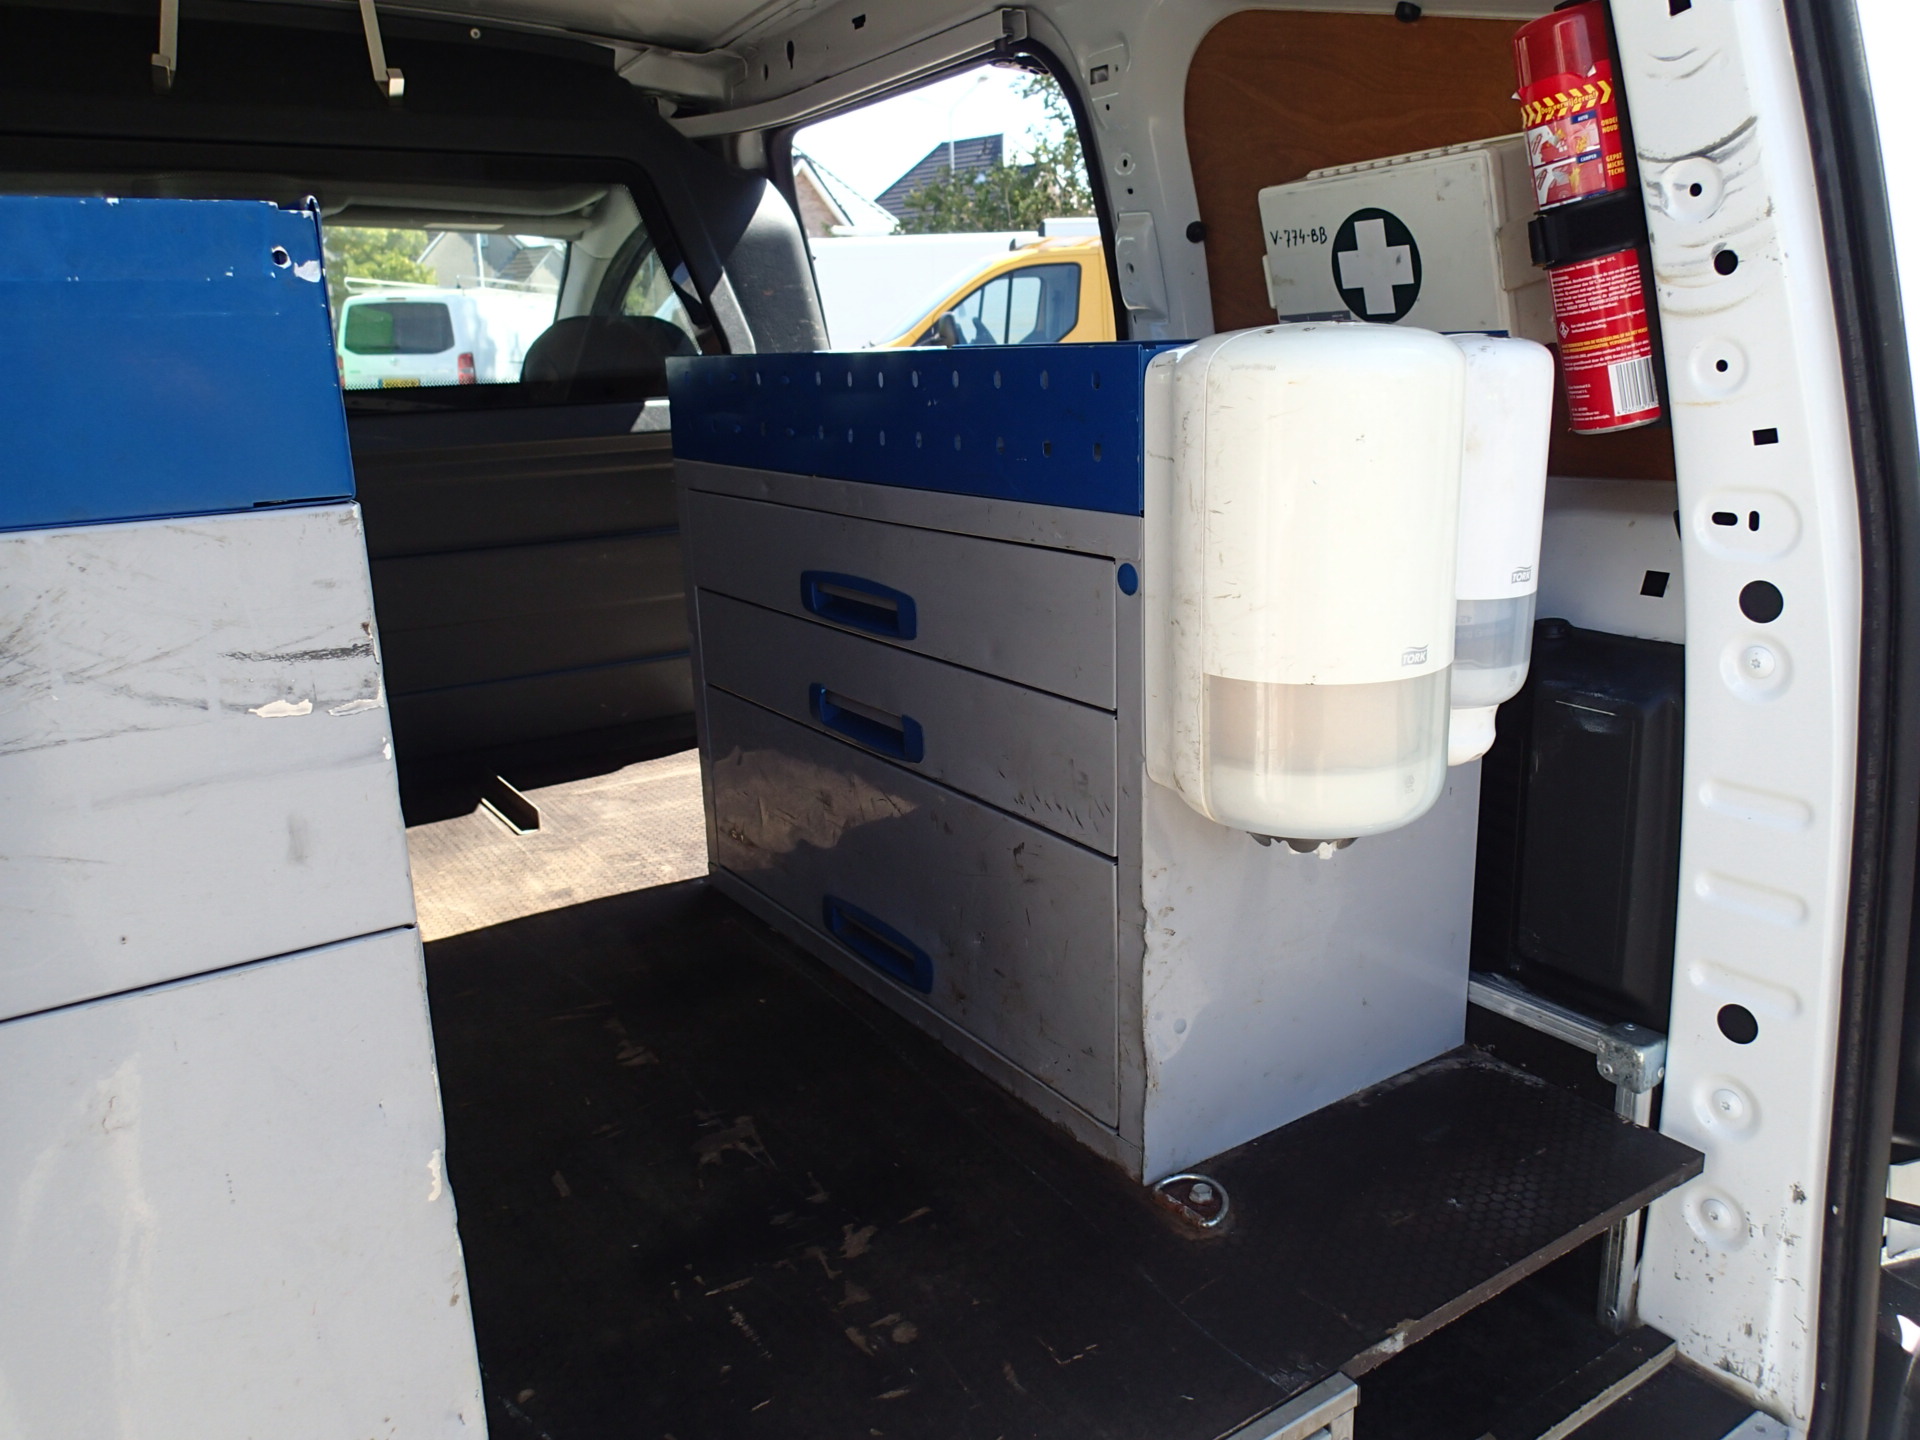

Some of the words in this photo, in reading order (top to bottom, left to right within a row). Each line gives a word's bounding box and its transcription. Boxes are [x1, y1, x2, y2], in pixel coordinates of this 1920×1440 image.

[1601, 124, 1619, 134] HOUD
[1269, 225, 1328, 248] V-774-BB
[1511, 569, 1532, 584] TORK
[1403, 651, 1428, 665] TORK
